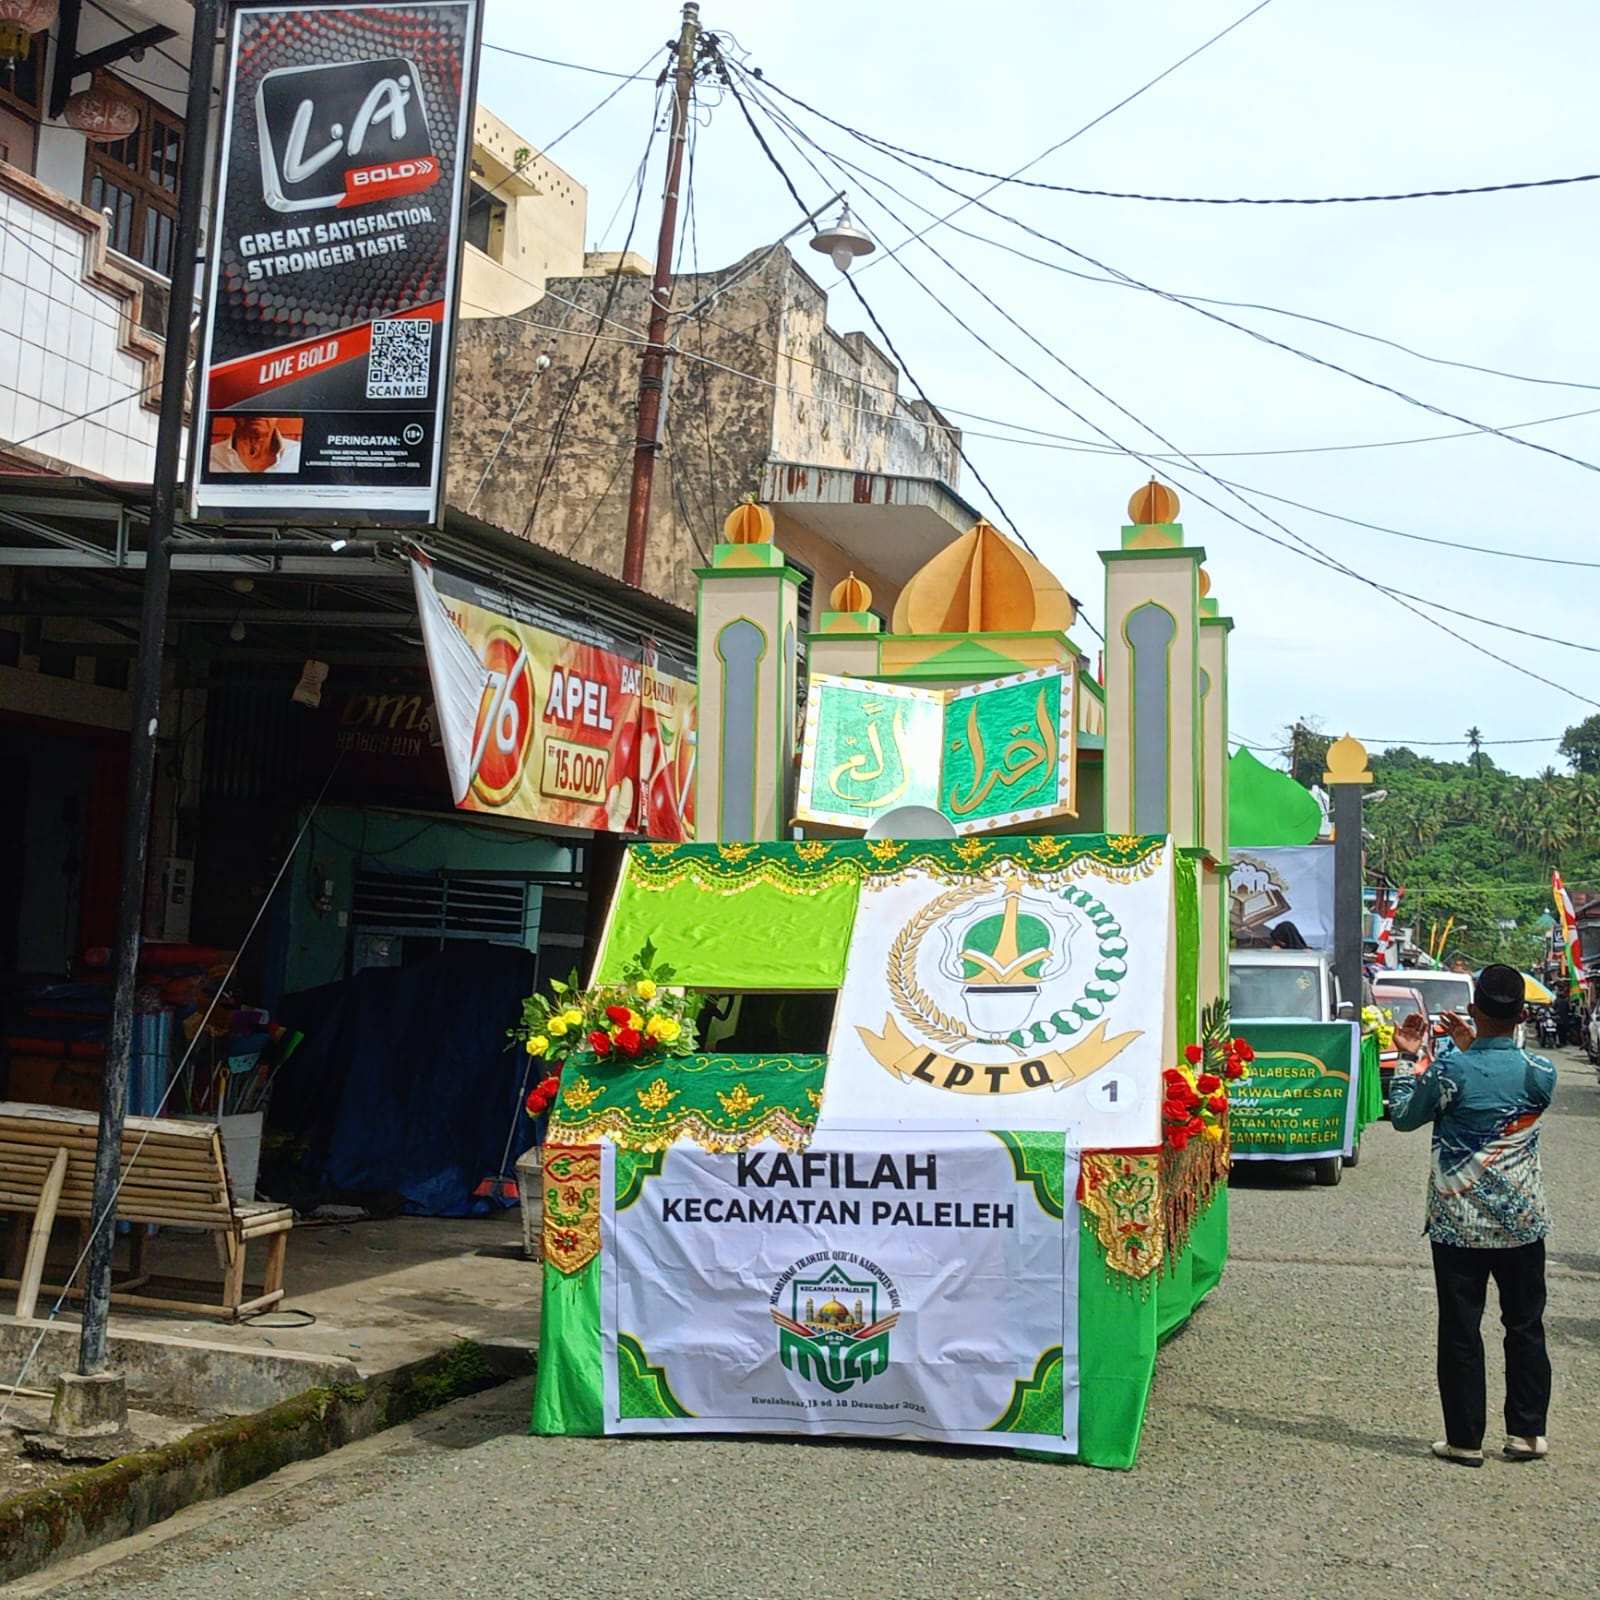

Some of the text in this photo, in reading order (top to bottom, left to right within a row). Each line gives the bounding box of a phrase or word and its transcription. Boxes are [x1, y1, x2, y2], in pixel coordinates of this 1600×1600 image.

[352, 166, 416, 186] BOLD
[239, 228, 311, 257] GREAT
[247, 233, 408, 282] STRONGER TASTE
[258, 341, 339, 384] LIVE BOLD
[368, 386, 427, 397] SCAN ME!
[327, 435, 401, 446] PERINGATAN:
[546, 671, 613, 731] APEL
[555, 748, 605, 795] 15.000
[912, 1052, 1054, 1093] LPTQ
[1249, 1067, 1316, 1079] ALABESAR
[1101, 1080, 1120, 1102] 1
[1238, 1087, 1344, 1099] KWALABESAR
[1232, 1118, 1266, 1129] ATAN
[1302, 1118, 1320, 1129] KE
[1230, 1129, 1338, 1146] CAMATAN PALELEH
[737, 1152, 938, 1190] KAFILAH
[662, 1198, 1015, 1229] KECAMATAN PALELEH
